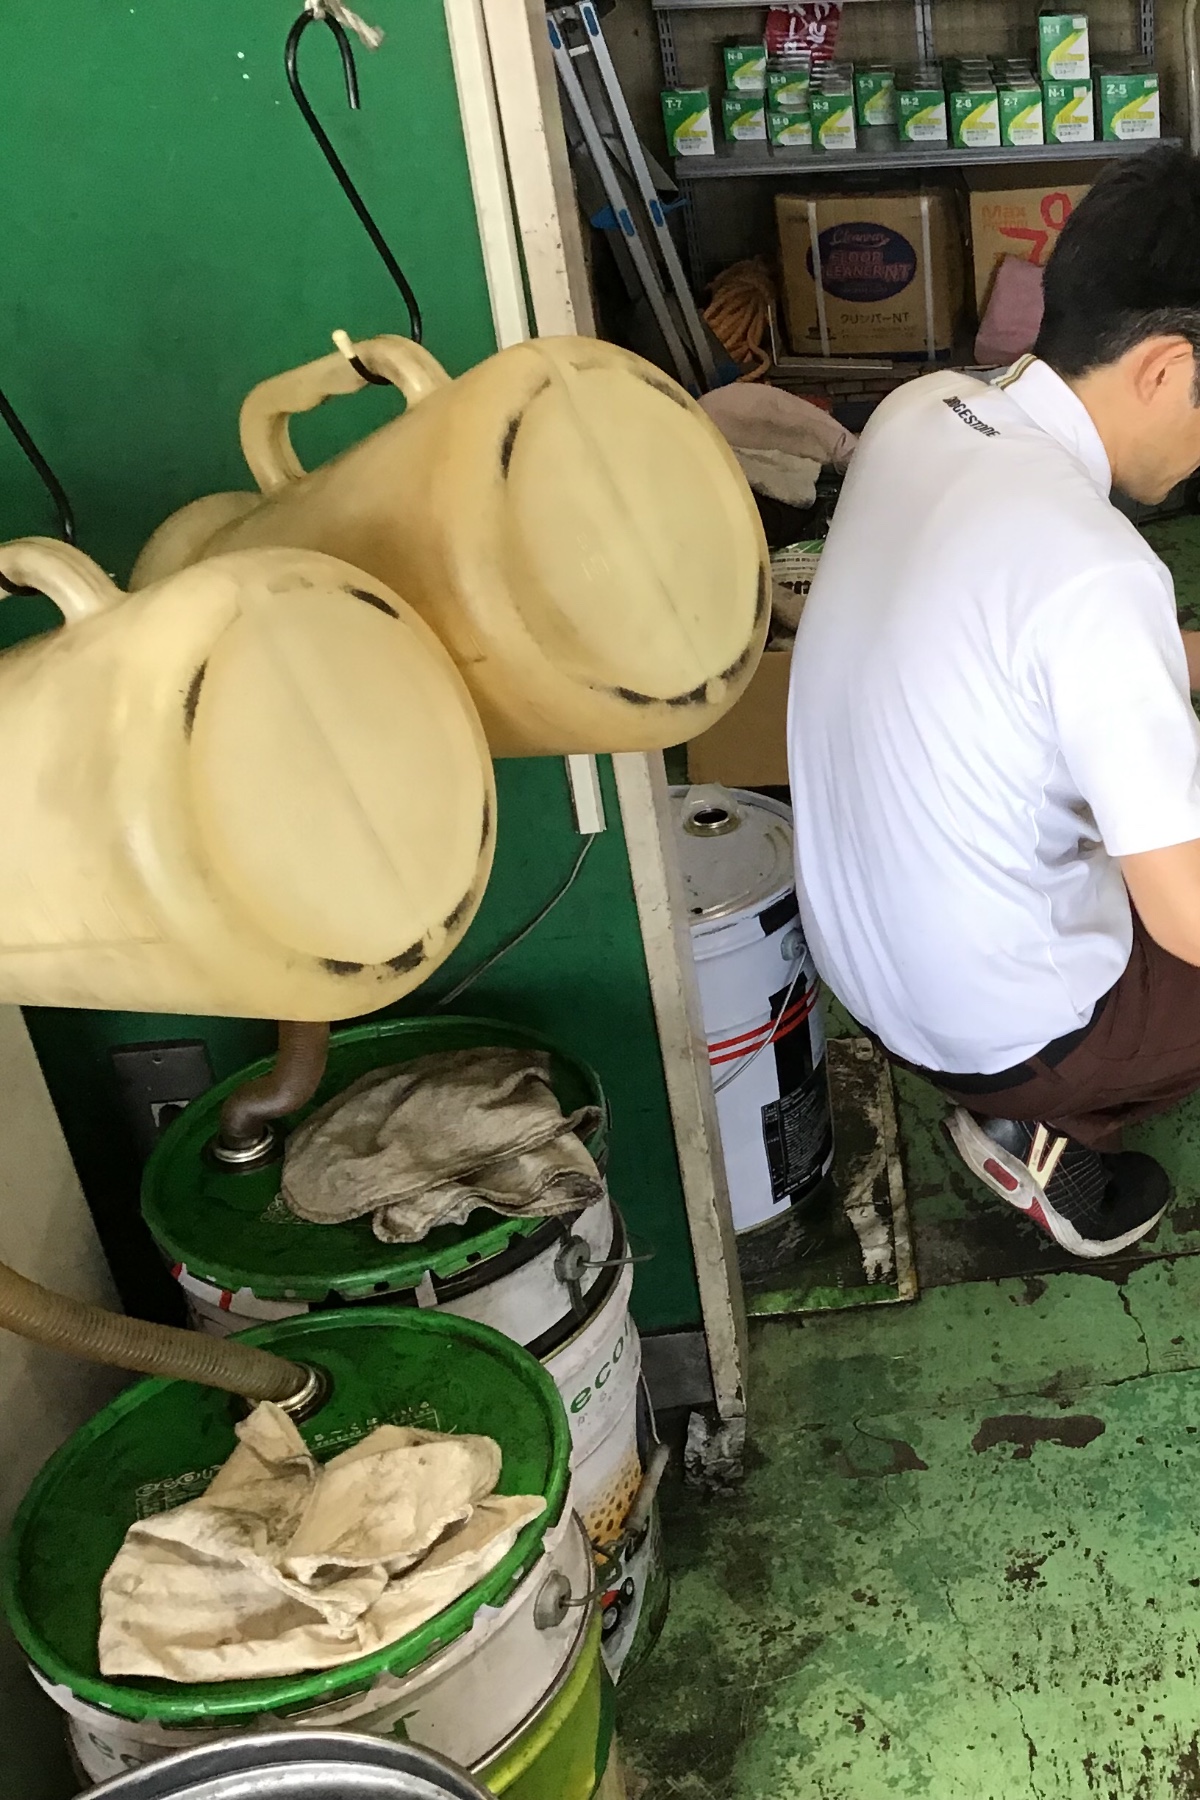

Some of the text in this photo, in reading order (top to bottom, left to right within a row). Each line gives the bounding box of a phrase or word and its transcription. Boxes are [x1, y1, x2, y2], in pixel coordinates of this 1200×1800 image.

[1043, 25, 1060, 34] N-1
[1048, 88, 1065, 97] N-1
[1106, 84, 1127, 95] Z-5
[665, 100, 682, 108] T-7
[1003, 98, 1018, 106] Z-7
[823, 265, 882, 278] LEANER
